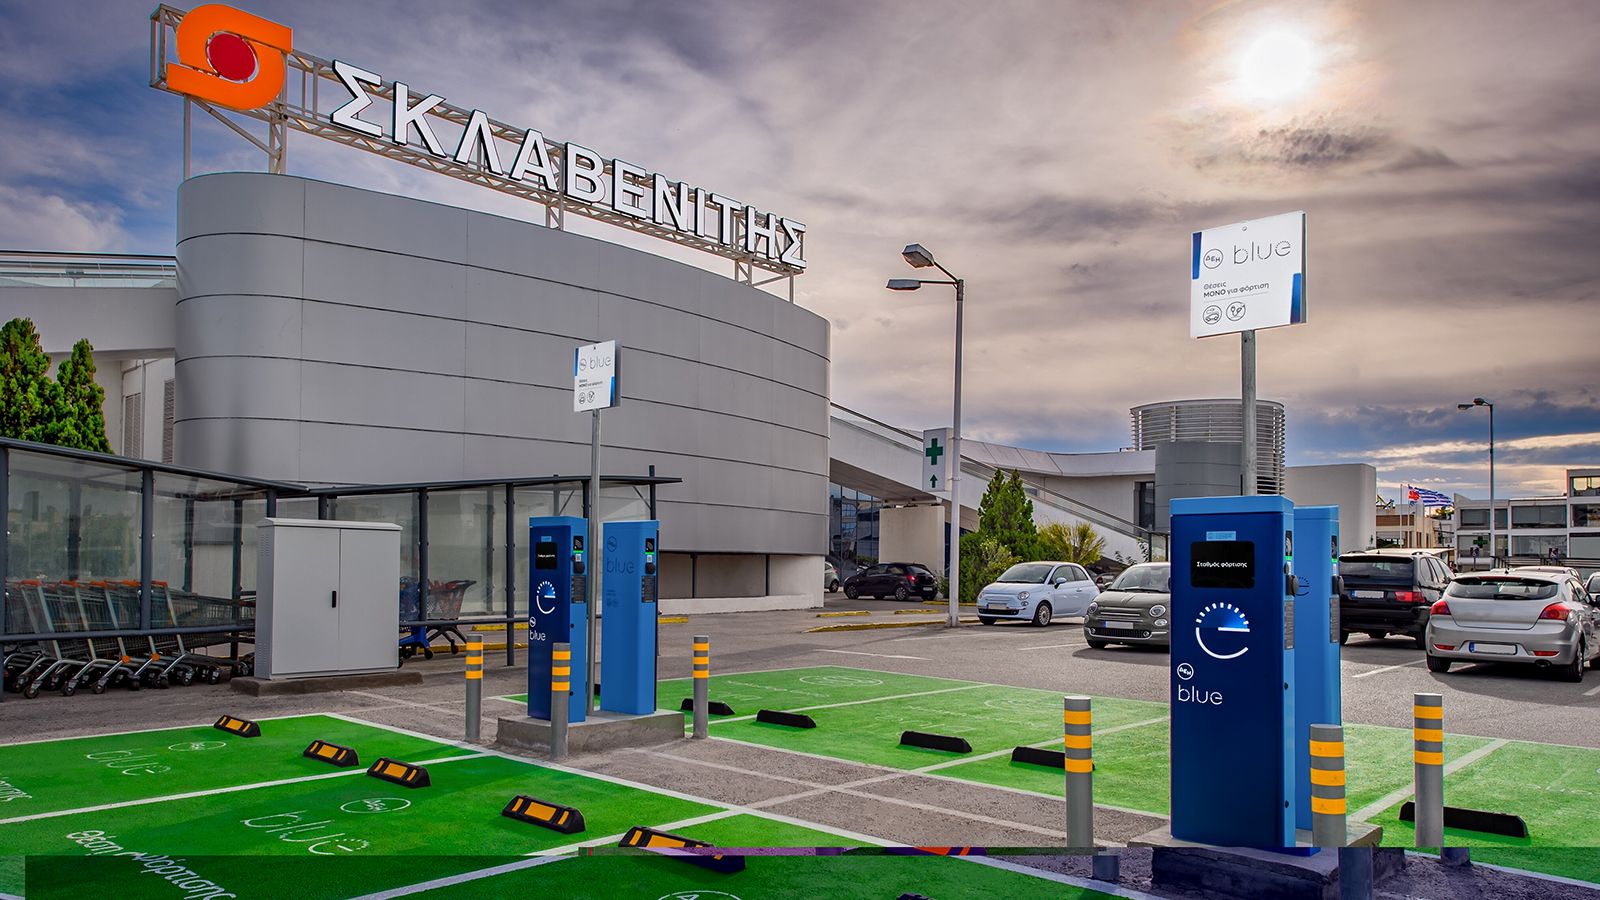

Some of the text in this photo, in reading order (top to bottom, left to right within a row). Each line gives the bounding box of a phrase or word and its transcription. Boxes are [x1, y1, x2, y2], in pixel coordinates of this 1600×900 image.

[330, 60, 807, 269] ΣΚΛΑΒΕΝΙΤΗΣ
[1233, 240, 1291, 264] blue
[1203, 282, 1270, 298] ΜΟΝΟ για φόρτιση
[589, 356, 611, 370] blue
[605, 557, 635, 575] blue
[529, 629, 546, 641] blue
[1178, 684, 1223, 705] blue
